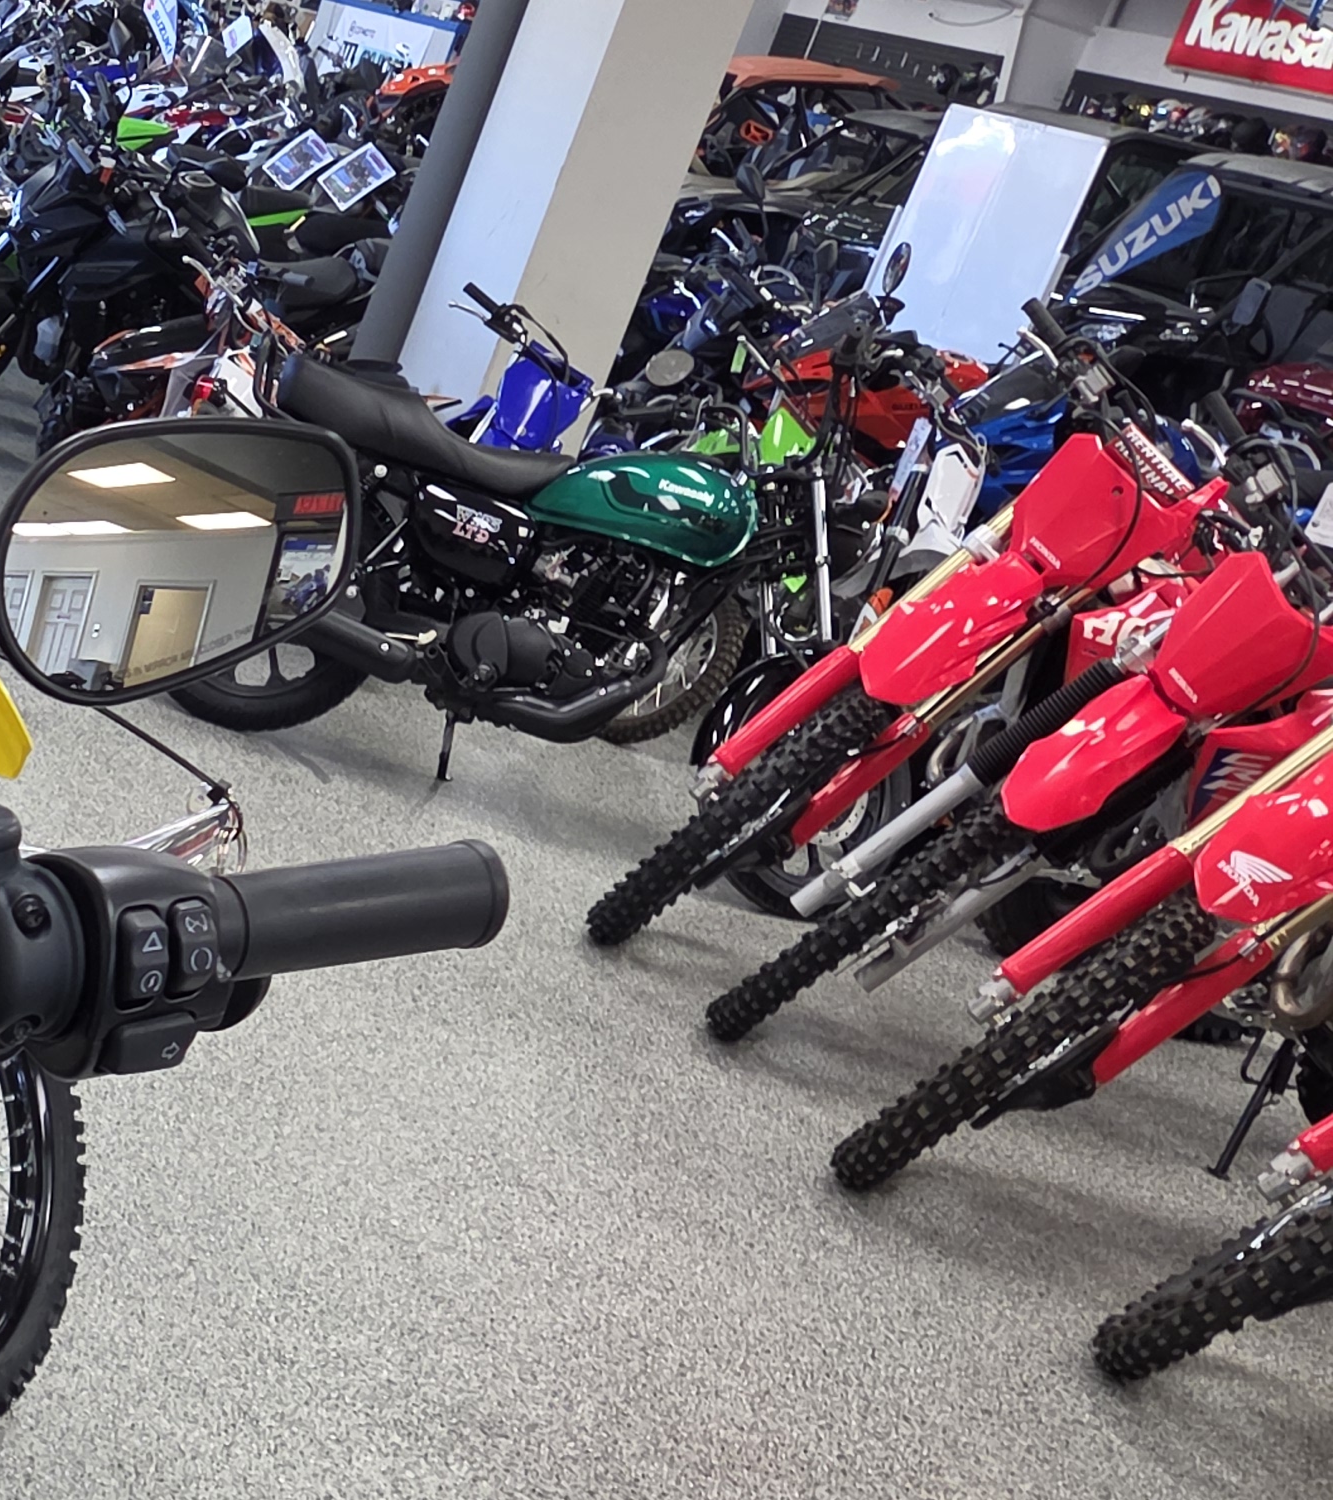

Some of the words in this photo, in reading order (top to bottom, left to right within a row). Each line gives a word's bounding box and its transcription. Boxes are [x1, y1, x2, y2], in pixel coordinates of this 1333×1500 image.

[1185, 0, 1333, 70] Kawasa
[1073, 174, 1221, 297] SUZUKI
[451, 521, 490, 544] LTD
